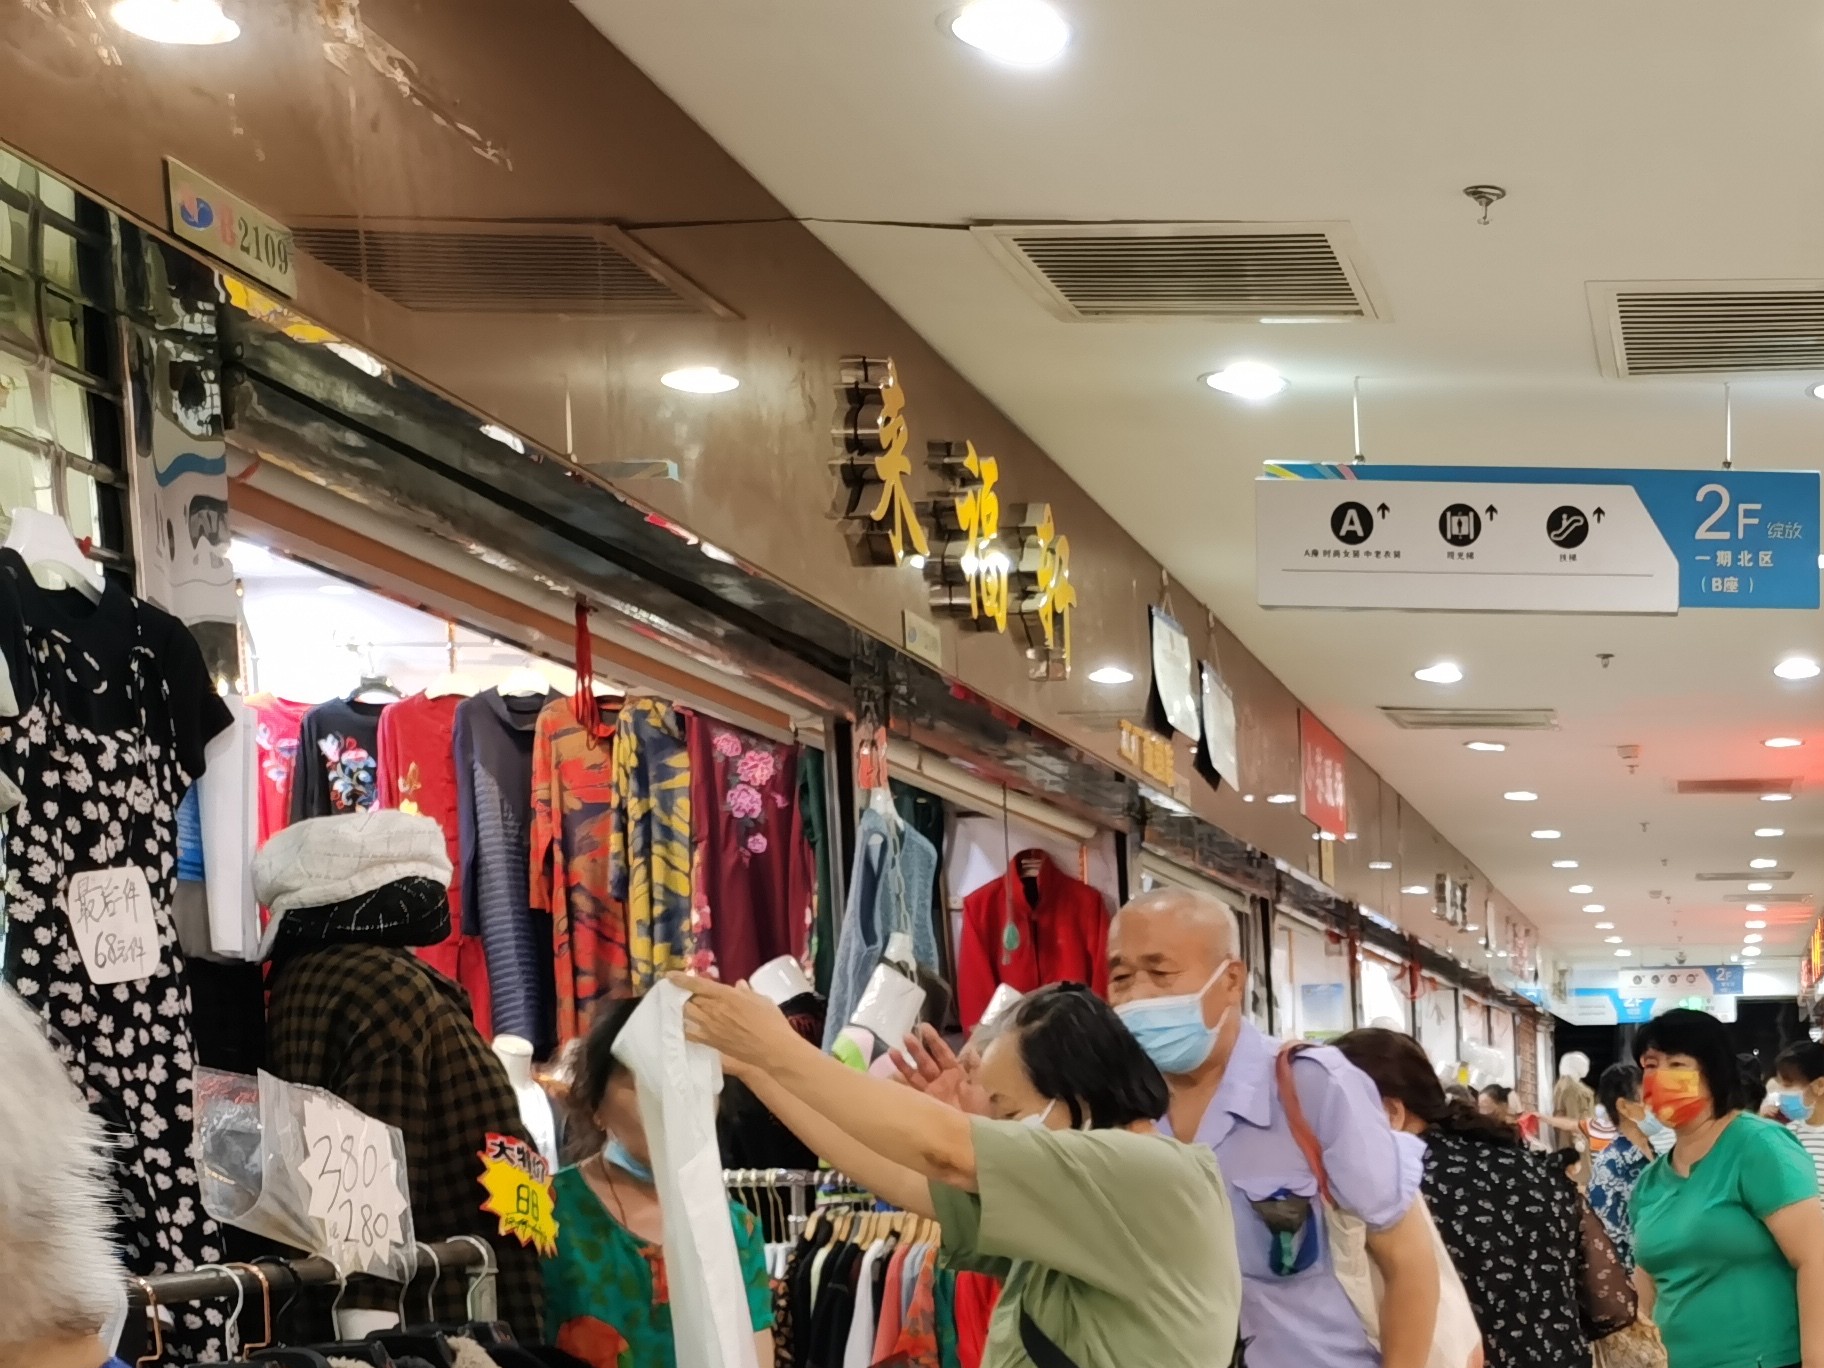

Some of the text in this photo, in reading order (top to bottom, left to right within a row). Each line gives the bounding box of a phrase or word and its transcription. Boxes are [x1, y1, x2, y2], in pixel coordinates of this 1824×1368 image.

[1338, 508, 1365, 537] A
[1694, 483, 1803, 540] 2F 绽放
[1694, 550, 1774, 567] 一期北区
